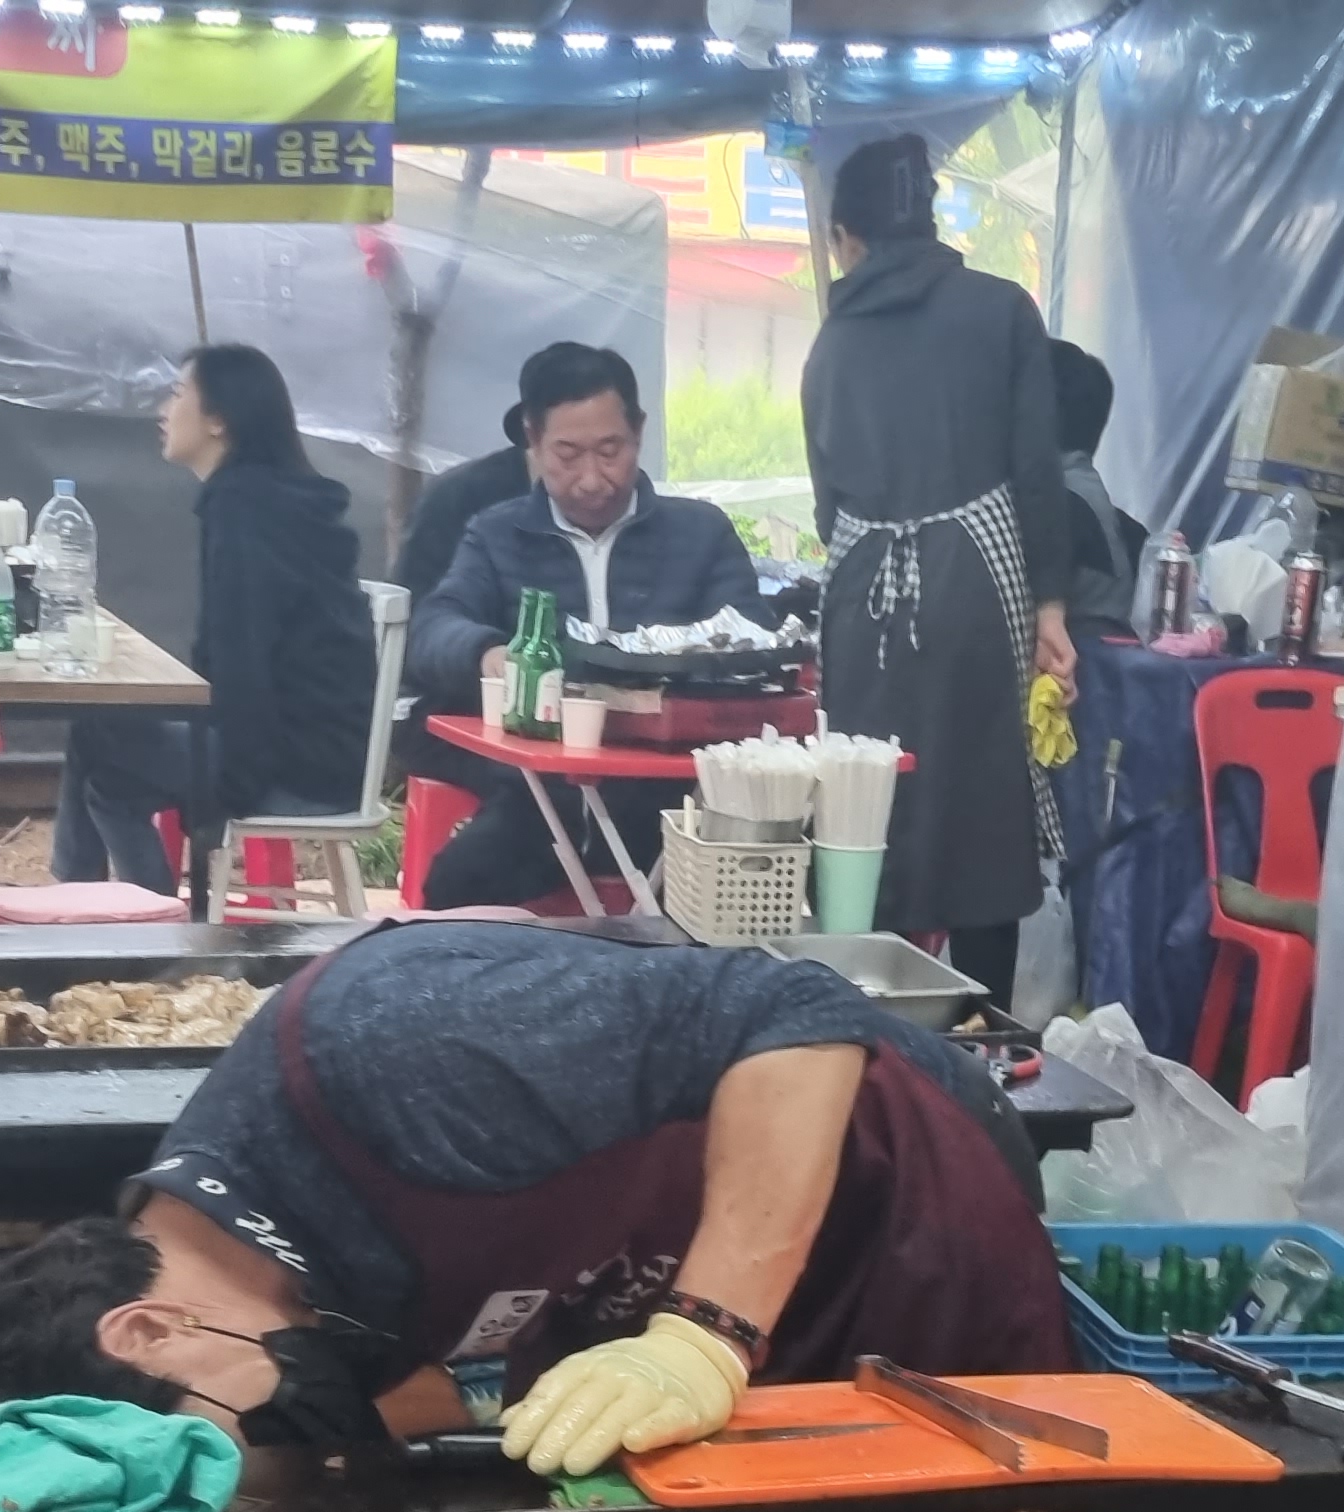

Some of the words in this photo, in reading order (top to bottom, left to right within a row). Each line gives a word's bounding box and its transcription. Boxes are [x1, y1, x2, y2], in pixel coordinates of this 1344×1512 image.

[58, 122, 139, 178] 맥주,
[152, 127, 264, 180] 막걸리,
[275, 128, 376, 178] 음료수
